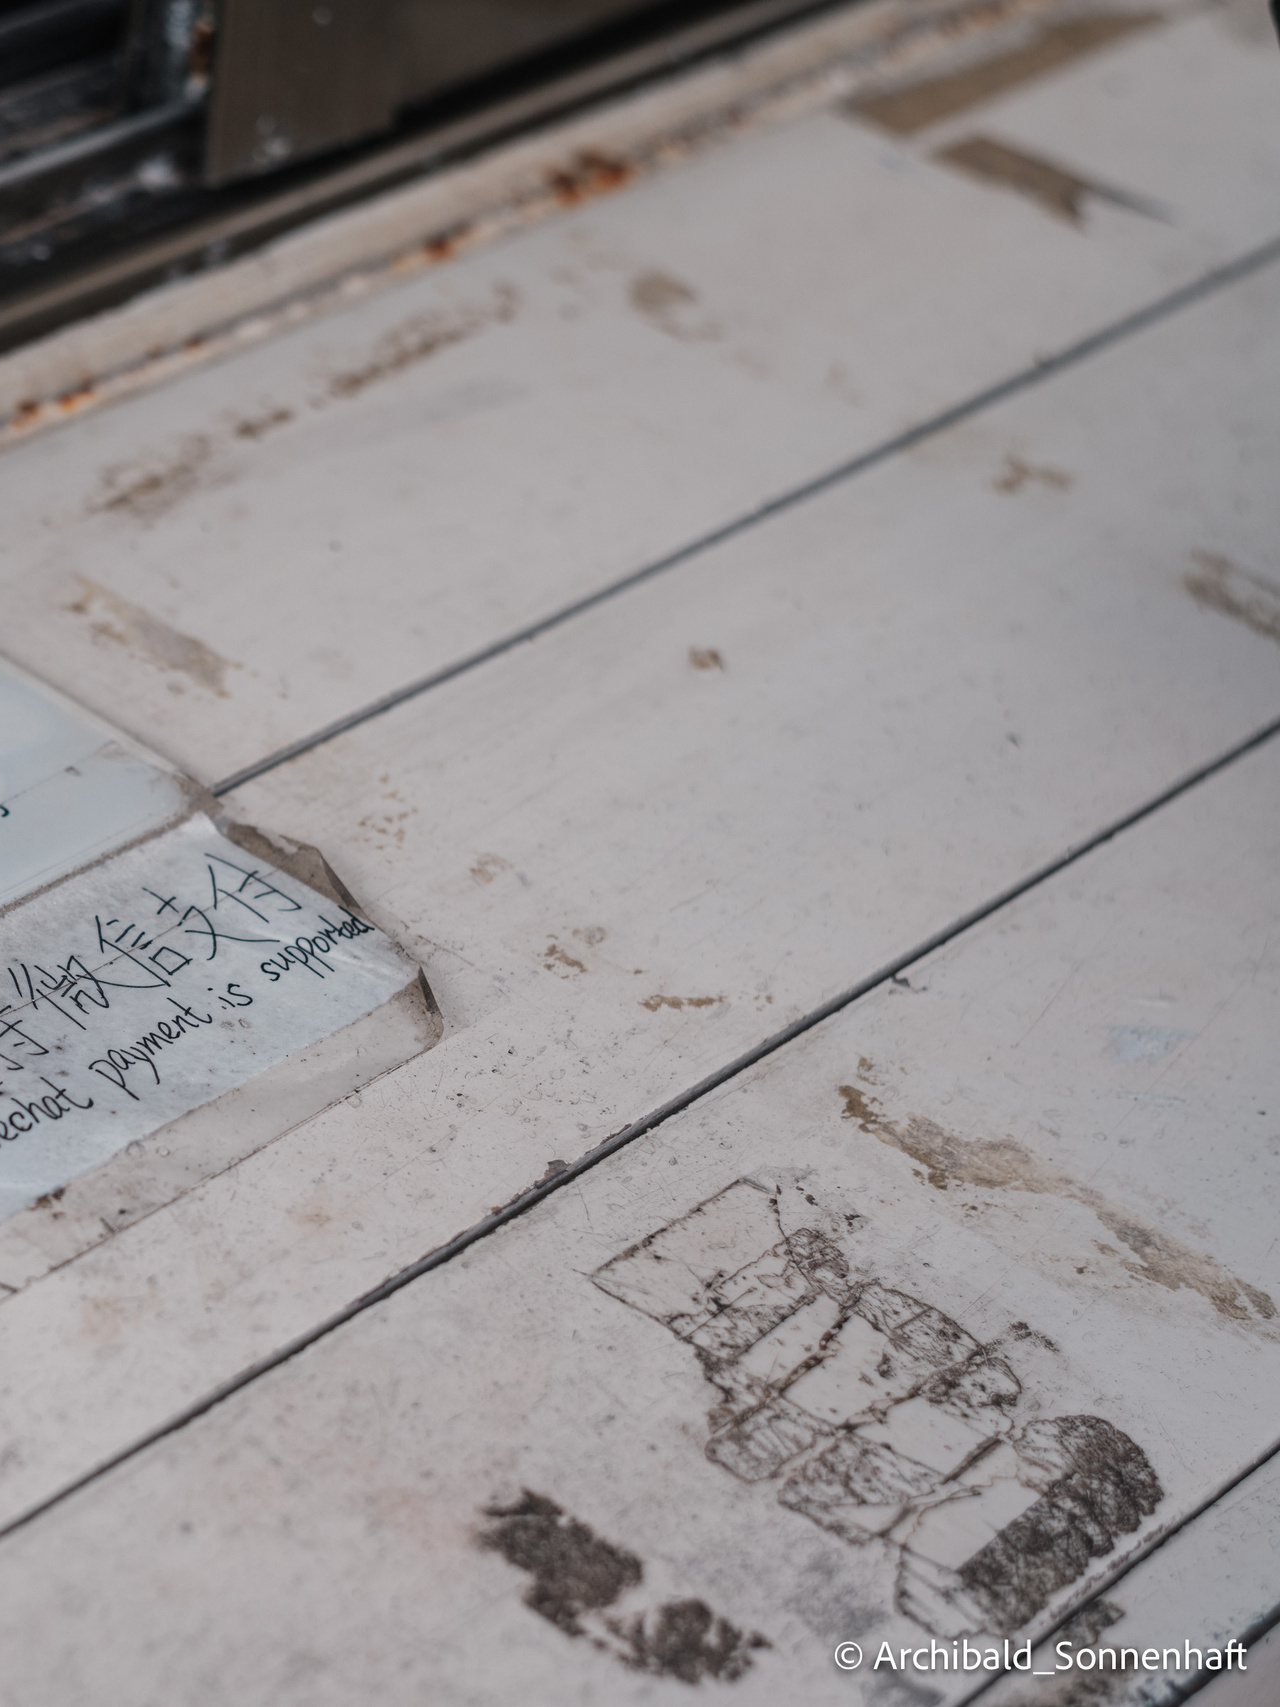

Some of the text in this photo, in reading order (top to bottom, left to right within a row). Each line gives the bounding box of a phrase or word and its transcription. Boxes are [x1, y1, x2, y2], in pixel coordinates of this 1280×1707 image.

[88, 996, 213, 1101] payment
[208, 982, 254, 1009] is
[260, 904, 375, 982] supported
